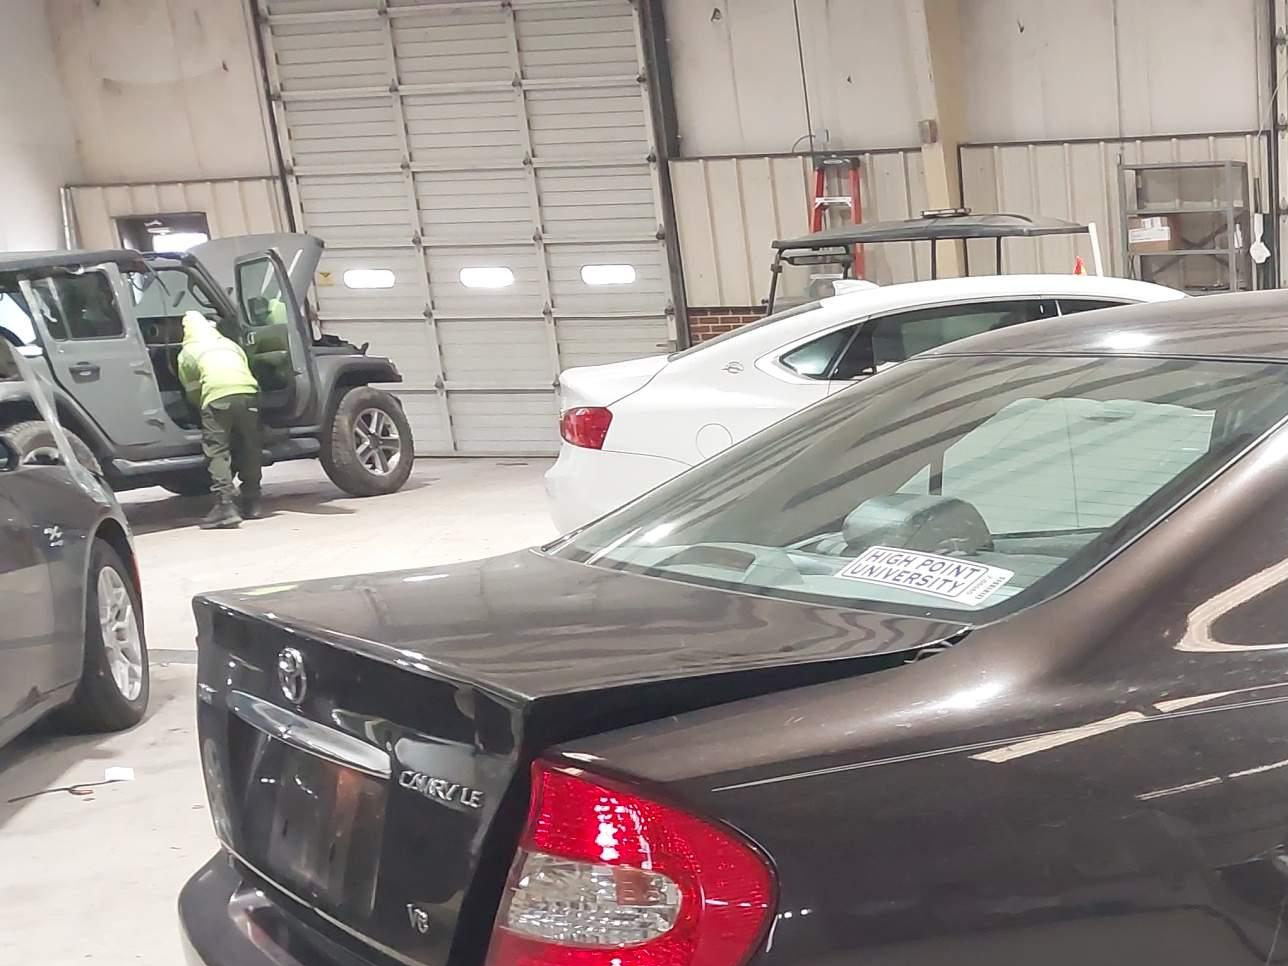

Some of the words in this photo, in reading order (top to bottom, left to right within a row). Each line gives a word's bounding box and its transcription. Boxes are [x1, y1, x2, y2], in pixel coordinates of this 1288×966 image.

[850, 563, 965, 593] UNIVERSITY
[865, 550, 917, 567] HIGH
[915, 559, 981, 580] POINT
[399, 770, 460, 801] CAMRY
[460, 787, 484, 808] LE
[406, 903, 429, 933] V6
